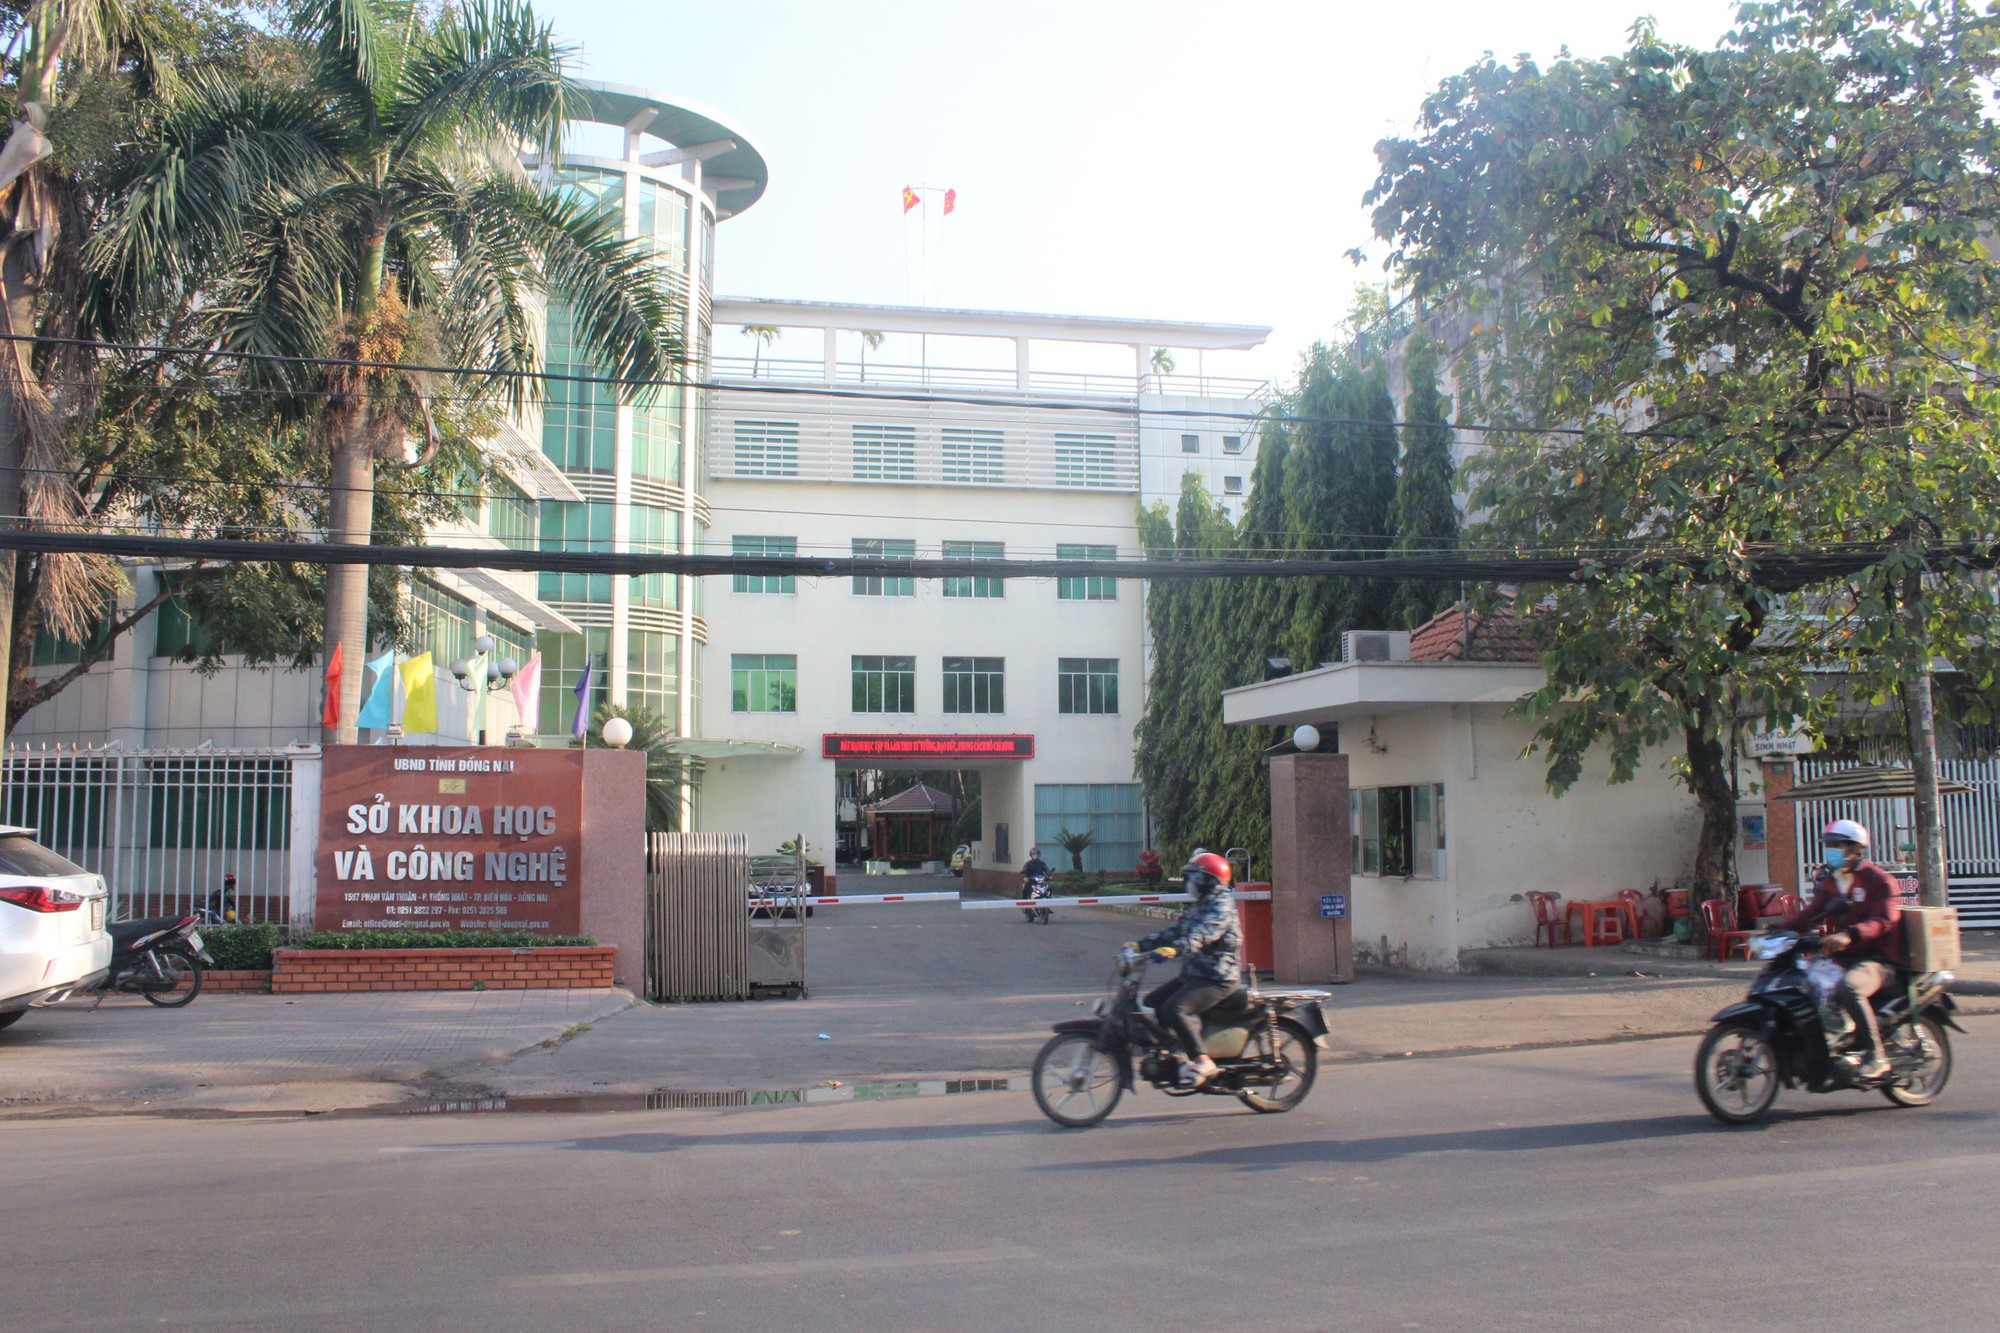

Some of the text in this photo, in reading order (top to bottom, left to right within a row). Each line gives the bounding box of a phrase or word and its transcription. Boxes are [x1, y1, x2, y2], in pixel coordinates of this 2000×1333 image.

[1755, 742, 1774, 751] SINH
[394, 755, 515, 772] UBND TỈNH ĐỒNG NAI
[347, 793, 556, 842] SỞ KHOA HỌC
[334, 844, 567, 887] VÀ CÔNG NGHỆ
[397, 906, 412, 915] 0251
[342, 919, 363, 928] Email:
[460, 919, 487, 929] Website:
